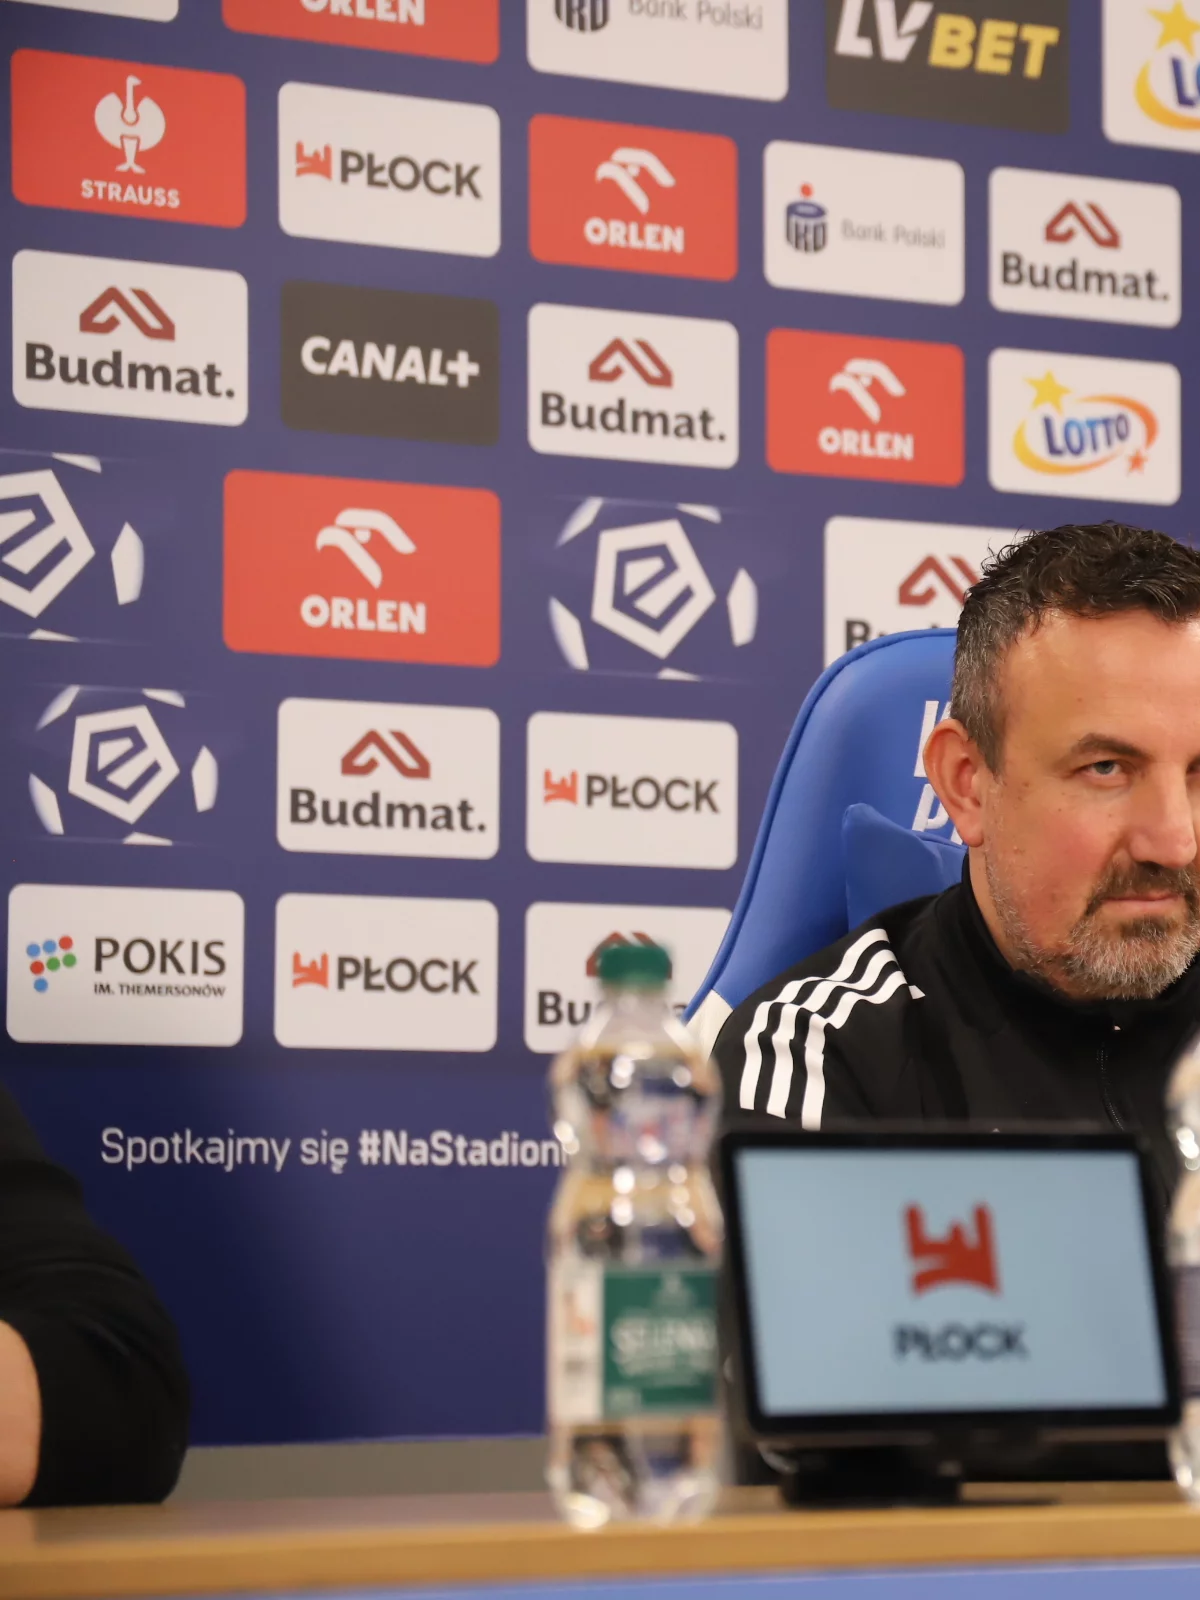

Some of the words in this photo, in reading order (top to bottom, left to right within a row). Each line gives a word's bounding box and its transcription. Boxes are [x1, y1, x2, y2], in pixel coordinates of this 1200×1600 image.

[696, 0, 764, 31] Polski
[928, 13, 1060, 79] BET
[81, 179, 180, 209] STRAUSS
[340, 150, 481, 200] PŁOCK
[584, 218, 685, 254] ORLEN
[841, 218, 887, 243] Bank
[892, 224, 947, 249] Polski
[1001, 252, 1168, 302] Budmat.
[25, 342, 235, 399] Budmat.
[301, 336, 480, 388] CANAL+
[540, 391, 727, 442] Budmat.
[1043, 414, 1130, 457] LOTTO
[818, 426, 913, 461] ORLEN
[300, 595, 427, 634] ORLEN
[289, 788, 486, 833] Budmat.
[585, 774, 720, 814] PŁOCK
[94, 937, 226, 976] POKIS
[337, 956, 479, 995] PŁOCK
[94, 982, 114, 996] IM.
[118, 982, 226, 998] THEMERSONÓW
[101, 1127, 292, 1173] Spotkajmy
[300, 1129, 349, 1174] się
[893, 1323, 1028, 1363] PŁOCK
